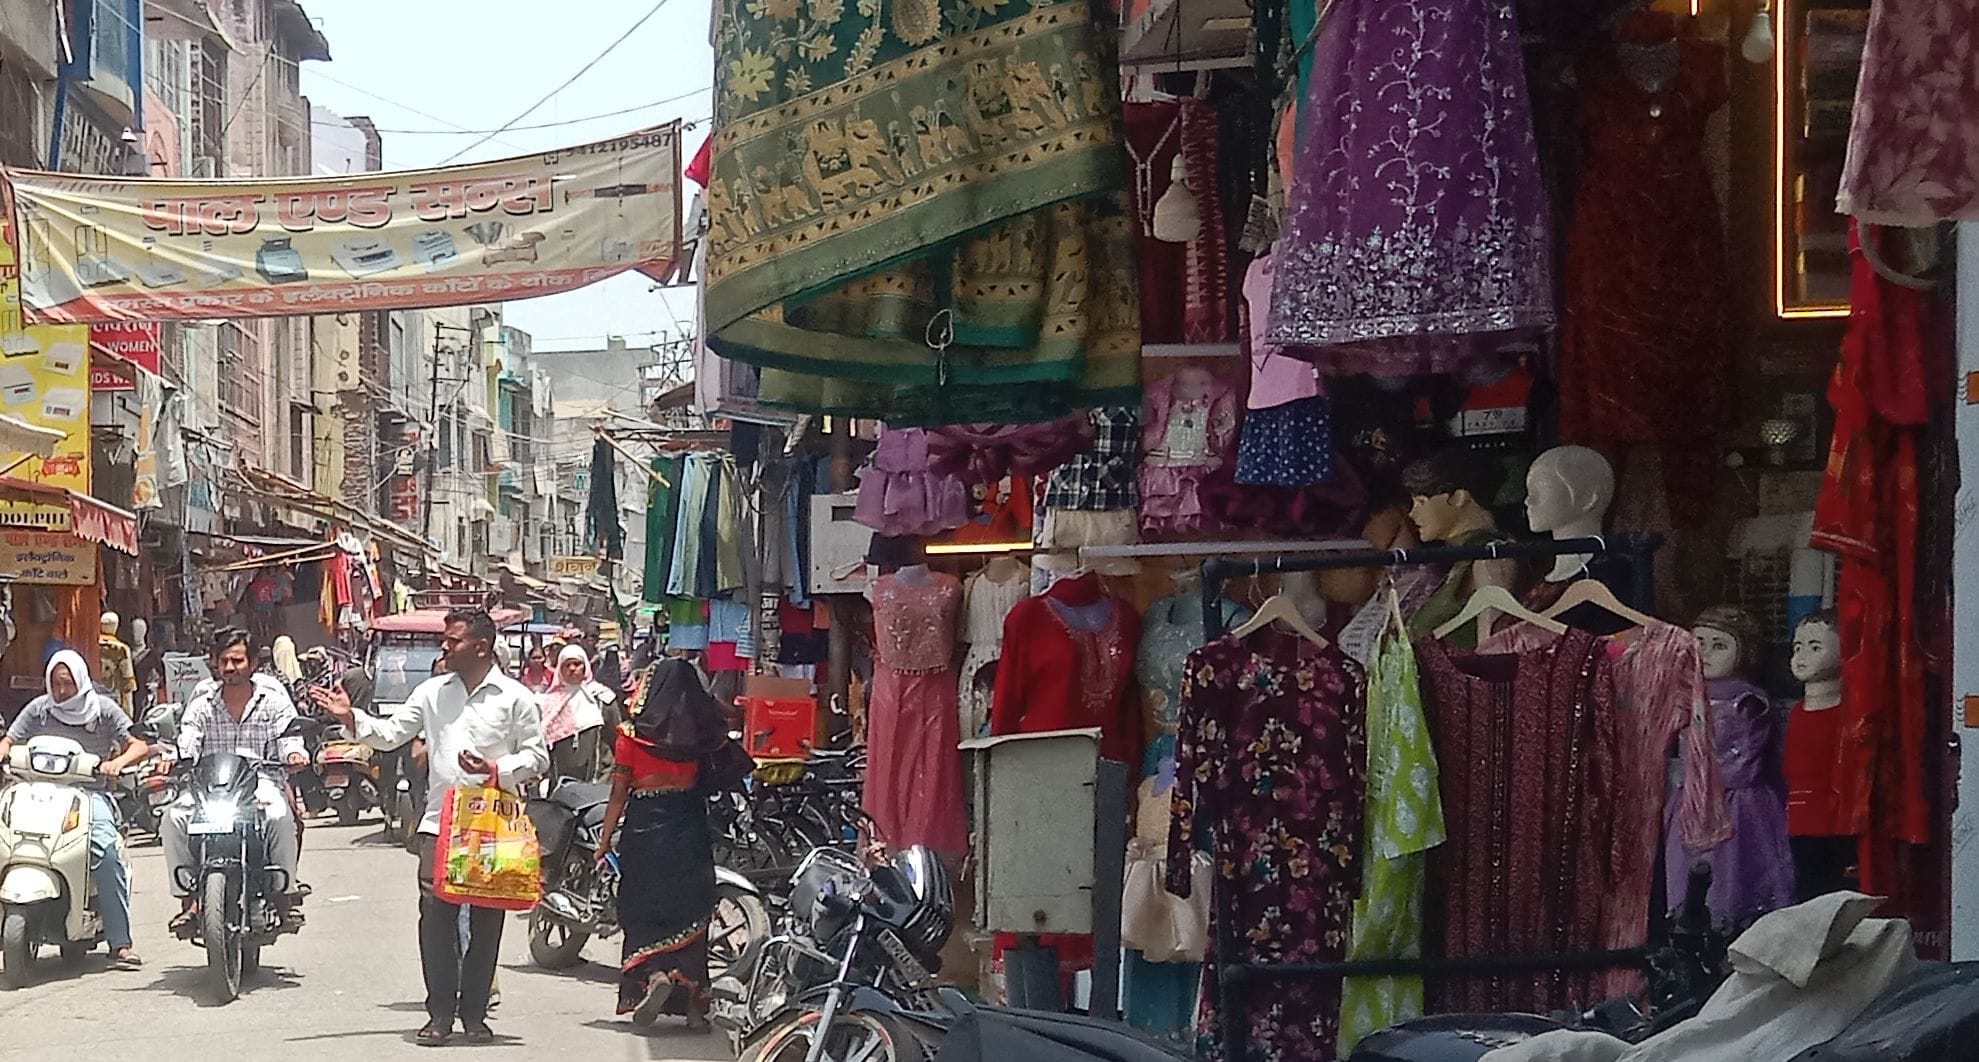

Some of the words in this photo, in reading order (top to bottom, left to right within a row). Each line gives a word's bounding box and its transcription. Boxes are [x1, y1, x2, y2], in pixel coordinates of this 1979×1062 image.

[567, 132, 673, 157] 12195487
[141, 193, 265, 236] पाल
[107, 340, 155, 353] WOMEN
[0, 512, 71, 524] DOLPHI
